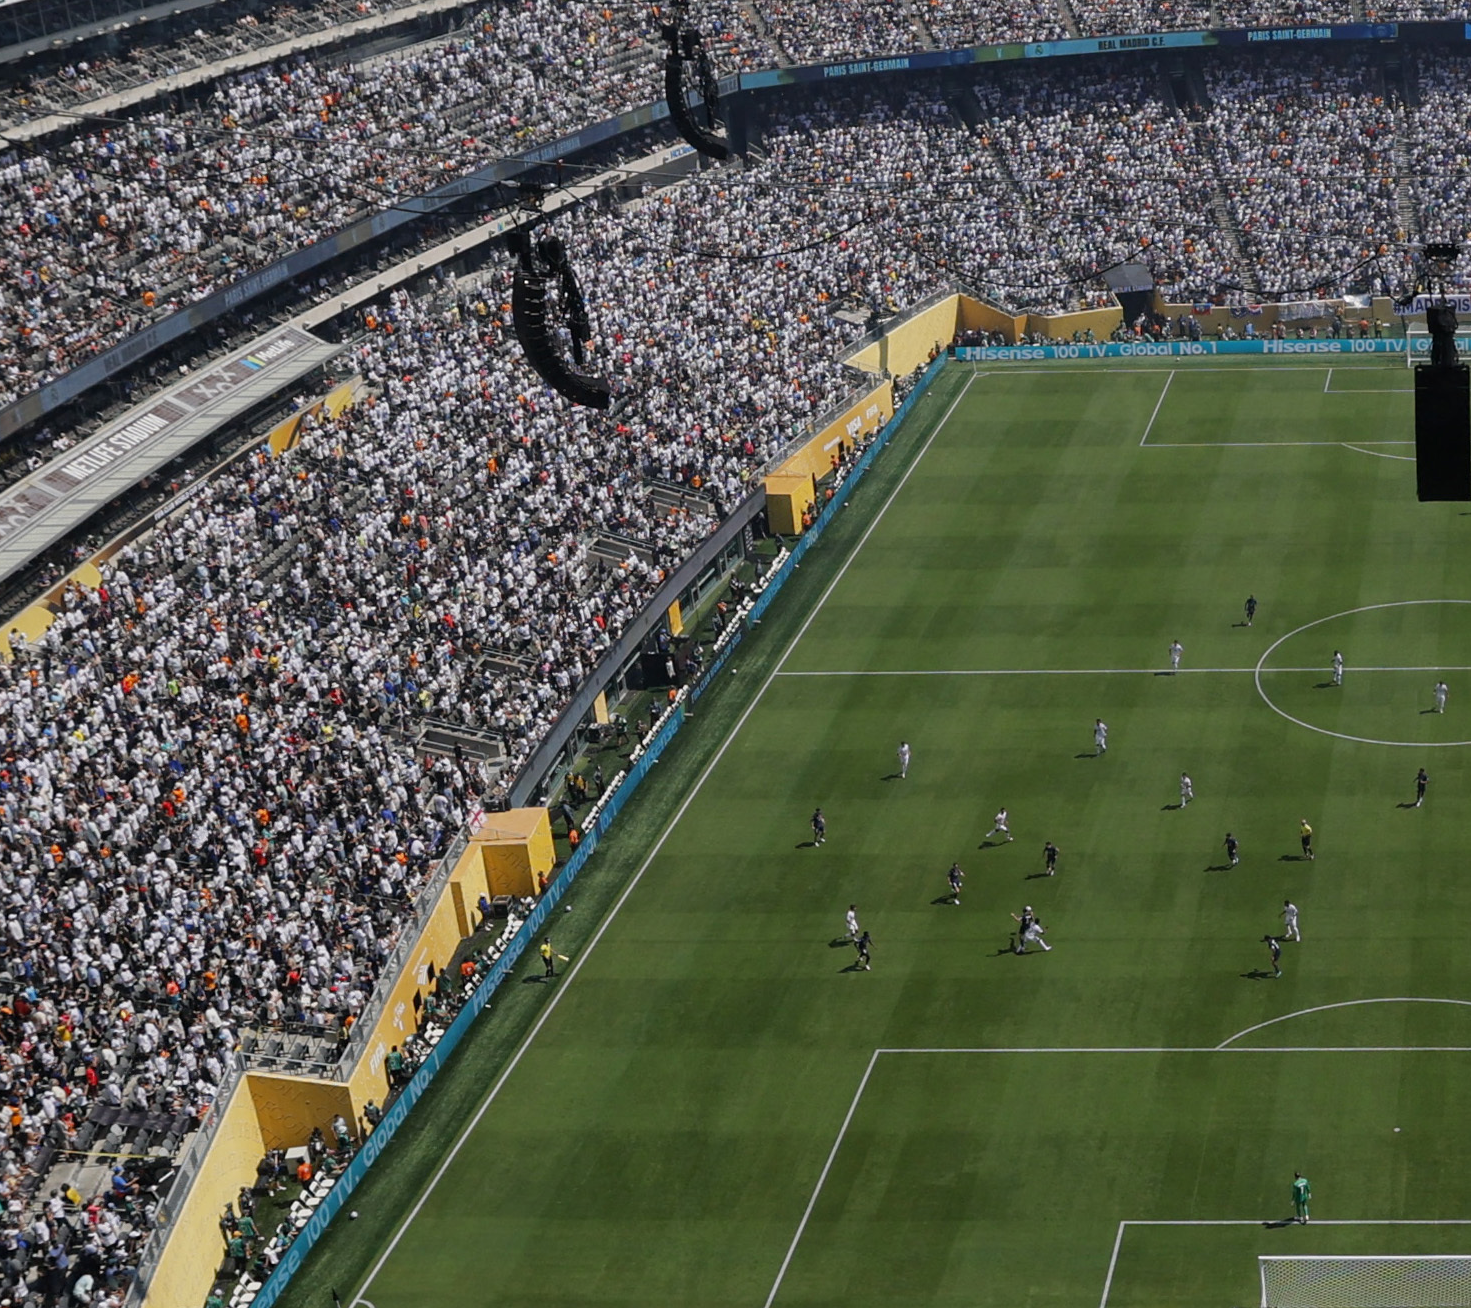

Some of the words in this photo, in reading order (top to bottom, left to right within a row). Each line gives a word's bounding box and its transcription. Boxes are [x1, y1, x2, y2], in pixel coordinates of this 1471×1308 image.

[1098, 39, 1126, 51] REAL
[1247, 30, 1270, 41] PARIS
[1272, 28, 1332, 41] SAINT-GERMAIN
[823, 64, 847, 78] PARIS
[847, 57, 910, 77] SAINT-GERMAIN
[966, 347, 1045, 361] Hisense
[1120, 343, 1172, 357] Global
[1263, 339, 1346, 353] Hisense
[61, 443, 118, 481] METLIFE
[110, 412, 169, 458] STADIUM
[639, 718, 679, 776] Hisense
[473, 936, 525, 1016] Hisense
[566, 827, 597, 883] Global
[363, 1101, 408, 1169] Global
